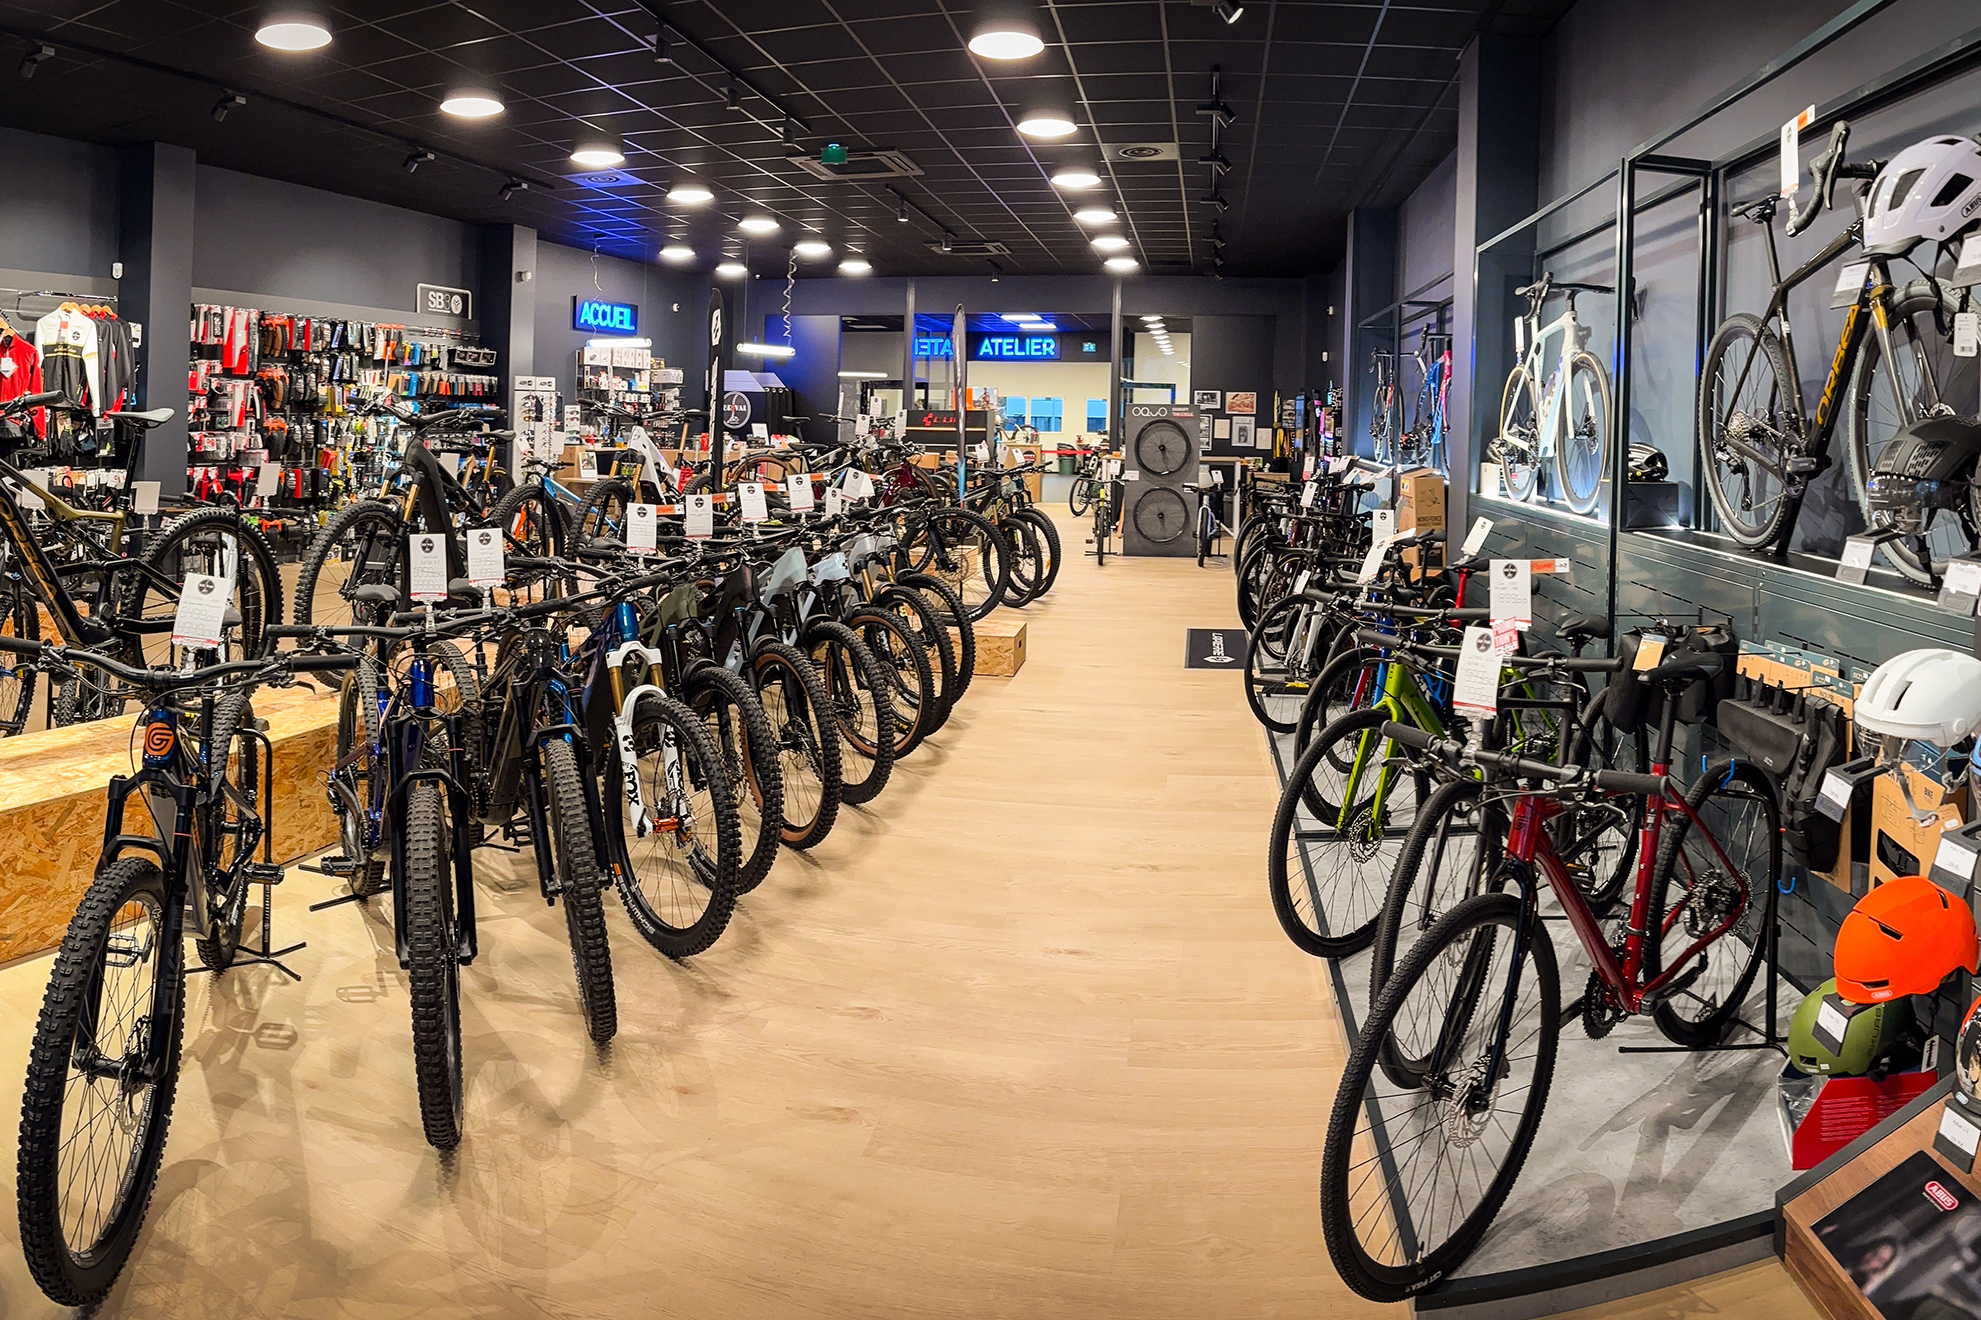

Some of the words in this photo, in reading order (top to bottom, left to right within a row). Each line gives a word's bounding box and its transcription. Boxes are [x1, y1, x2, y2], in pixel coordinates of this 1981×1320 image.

[580, 301, 635, 330] ACCUEIL
[979, 338, 1056, 356] ATELIER
[1817, 304, 1859, 425] ORBEA
[0, 497, 57, 600] ORBEA
[624, 770, 640, 807] FOX
[1928, 1184, 1956, 1208] ABUS
